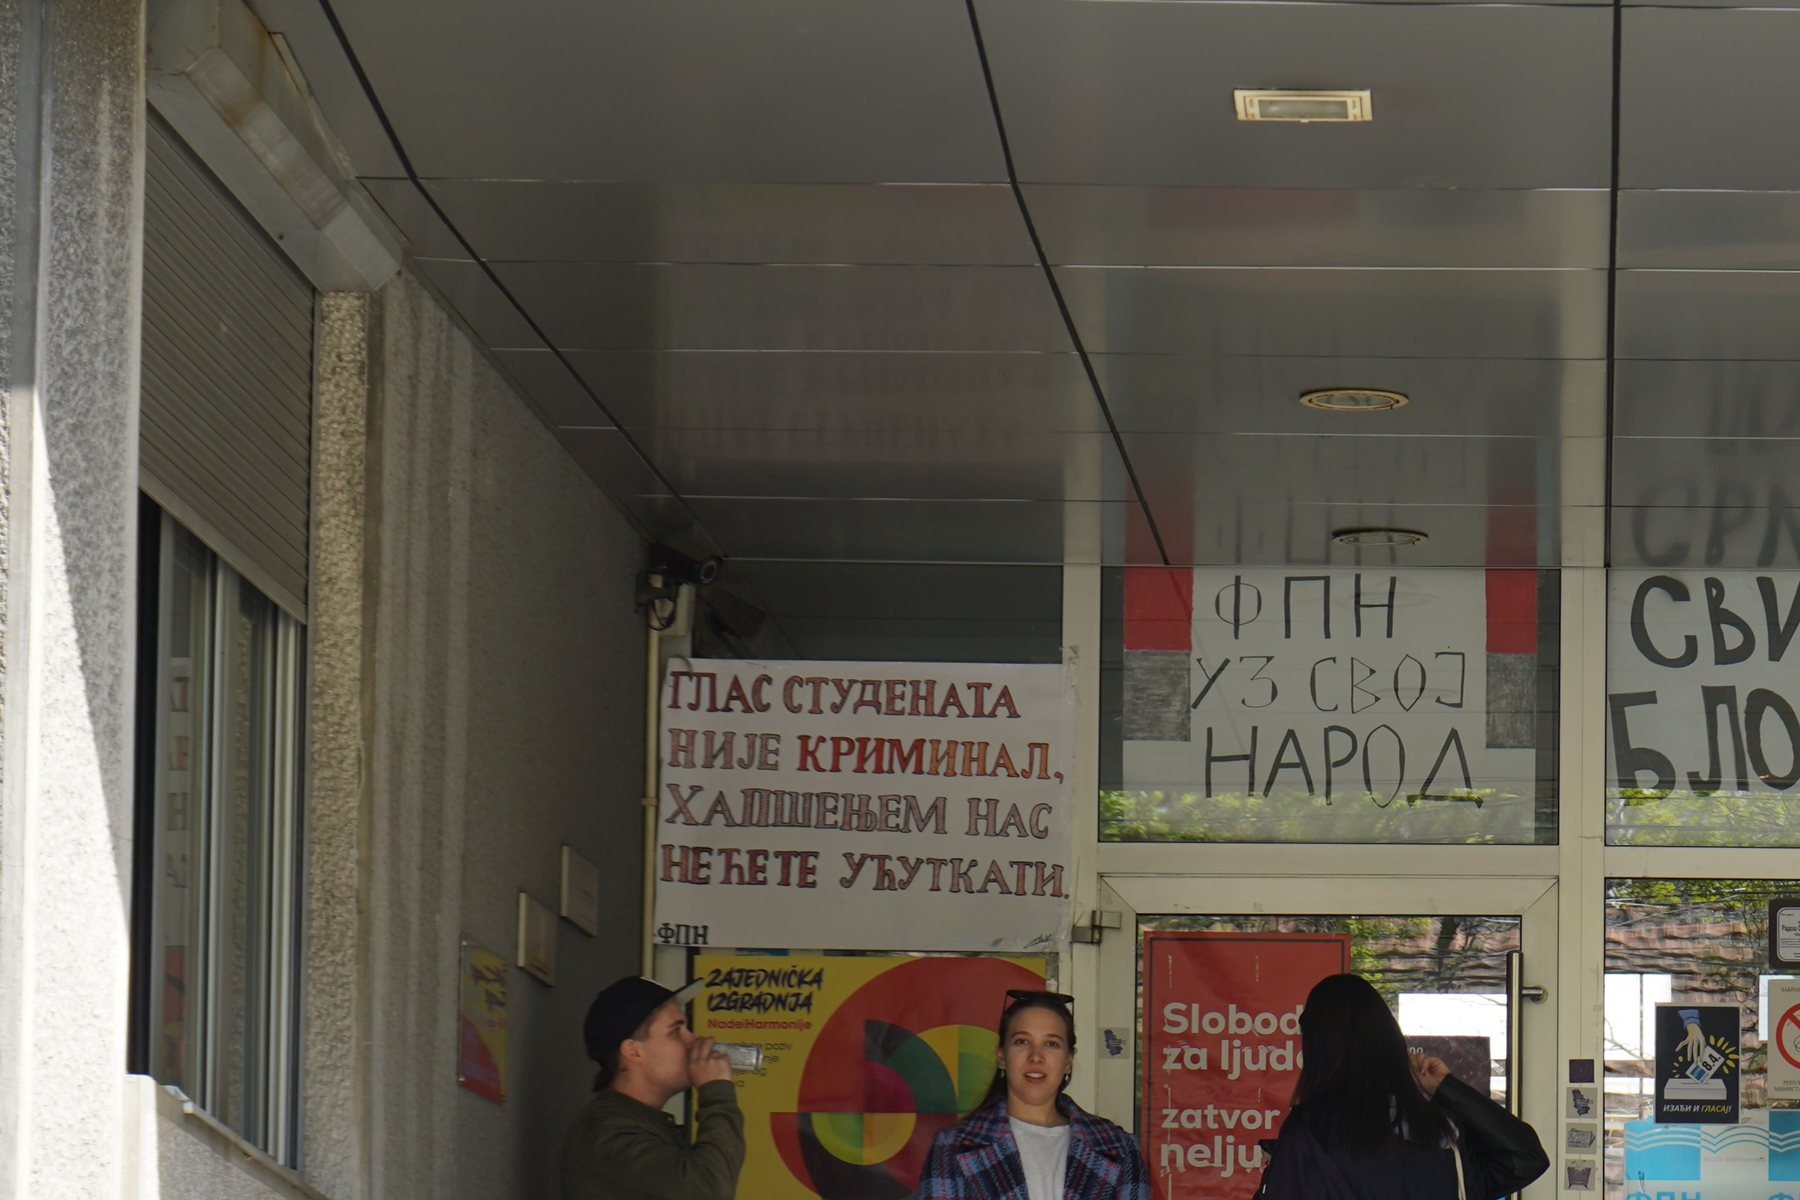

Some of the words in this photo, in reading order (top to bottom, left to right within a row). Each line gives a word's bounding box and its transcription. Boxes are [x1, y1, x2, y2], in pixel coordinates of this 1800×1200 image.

[1214, 573, 1397, 640] ФПН
[666, 671, 773, 714] ГЛАС
[782, 674, 1022, 719] СТУДЕНАТА
[1190, 656, 1279, 710] УЗ
[1309, 651, 1466, 715] СВОЈ
[667, 728, 782, 771] НИЈЕ
[796, 735, 1065, 784] КРИМИНАЛ,
[1205, 724, 1484, 810] НАРОД
[664, 783, 948, 835] ХАПШЕЊЕМ
[964, 797, 1054, 839] НАС
[660, 844, 820, 888] НЕЋЕТЕ
[838, 852, 1071, 901] УЋУТКАТИ.
[656, 923, 710, 945] ФПН
[704, 965, 824, 991] ZAJEDNIČKA
[706, 991, 814, 1015] IZGRADNJA
[1162, 1002, 1304, 1036] Slobod
[707, 1019, 742, 1029] Nade
[746, 1018, 812, 1032] Harmonije
[1161, 1045, 1208, 1071] za
[1161, 1104, 1281, 1130] zatvor
[1663, 1104, 1692, 1112] ИЗАЂИ
[1701, 1105, 1732, 1115] ГЛАСАЈ!
[1160, 1135, 1263, 1179] nelju
